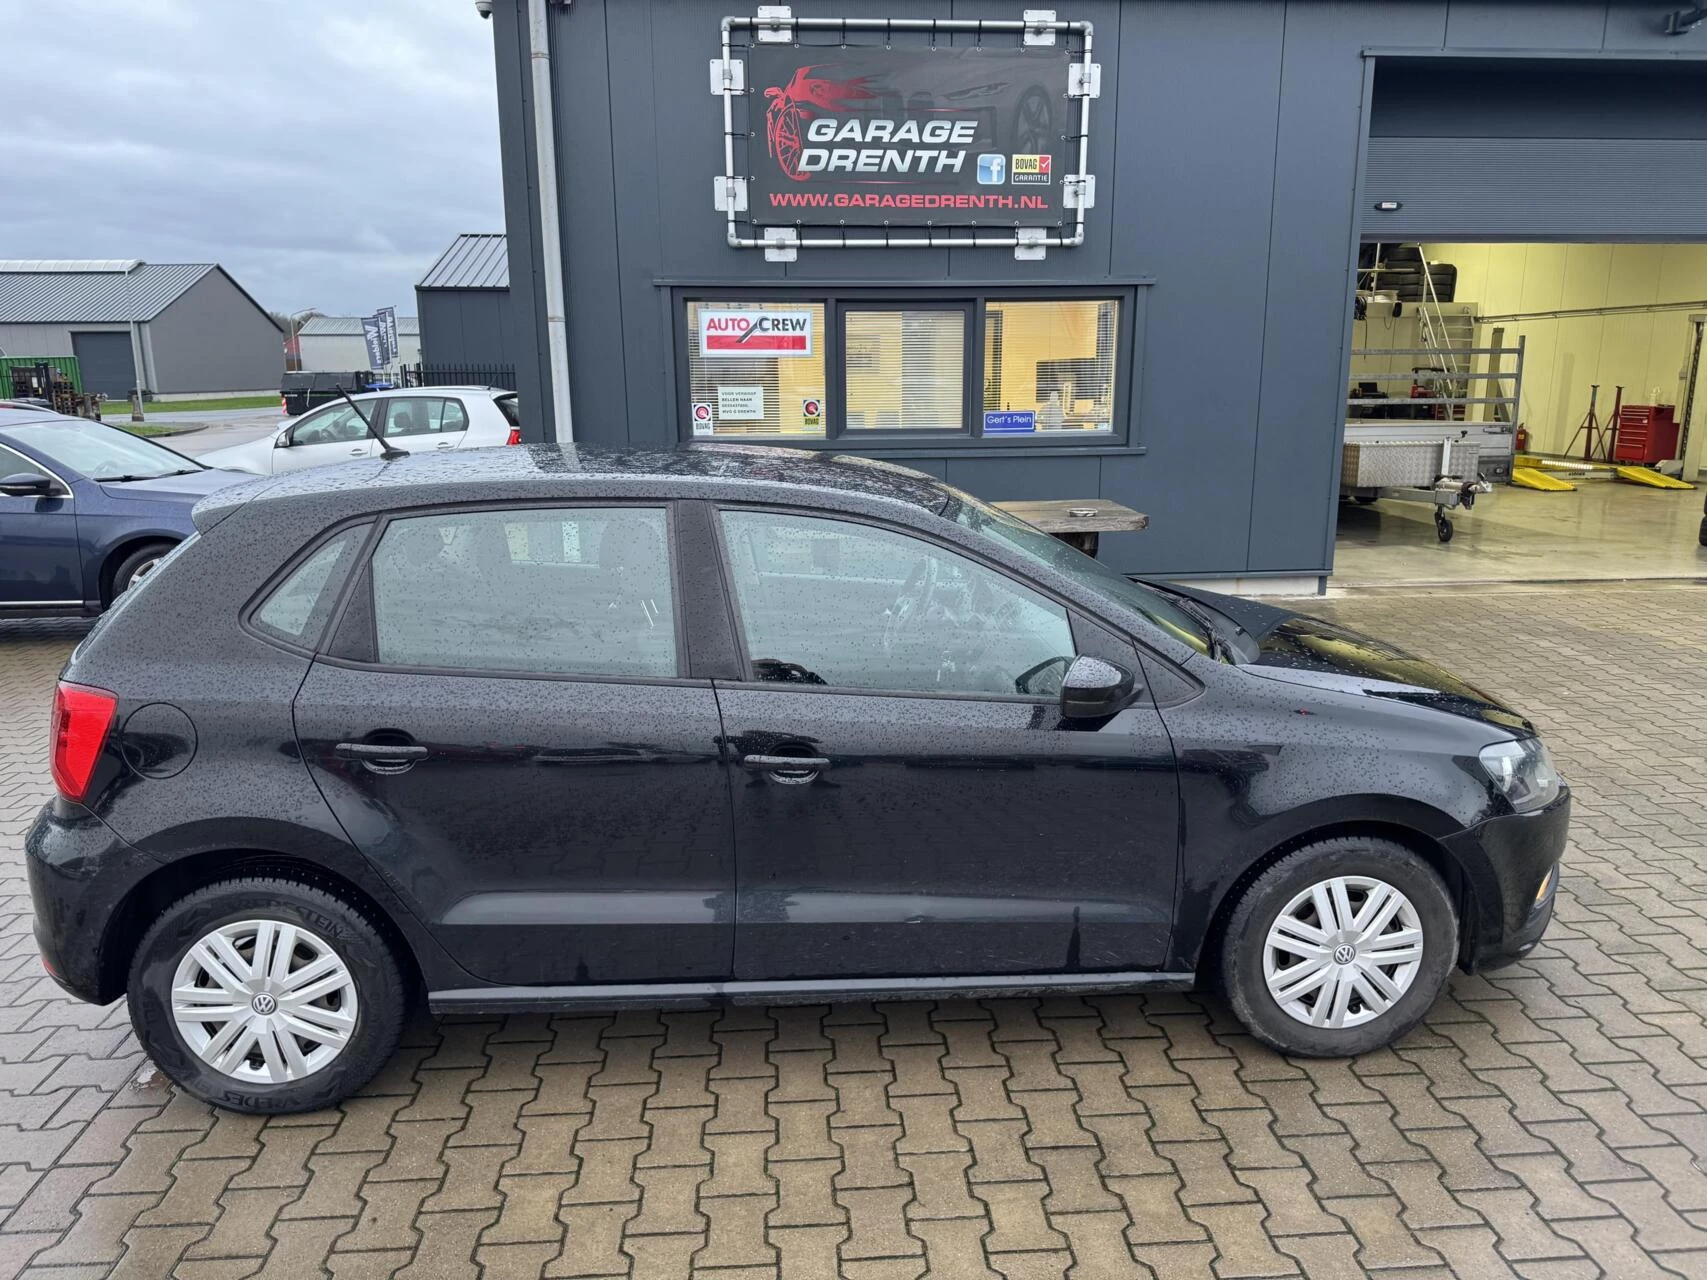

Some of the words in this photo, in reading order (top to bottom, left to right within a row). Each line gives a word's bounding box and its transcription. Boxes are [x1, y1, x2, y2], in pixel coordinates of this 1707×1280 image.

[807, 118, 978, 144] GARAGE
[798, 148, 966, 173] DRENTH
[1015, 158, 1038, 170] BOVAG
[1014, 174, 1048, 182] GARANTIE
[769, 193, 1049, 209] WWW.GARAGEDRENTH.NL
[706, 318, 750, 331] AUTO
[758, 316, 807, 332] CREW
[986, 415, 1011, 424] Gert's
[1012, 415, 1032, 424] Plein
